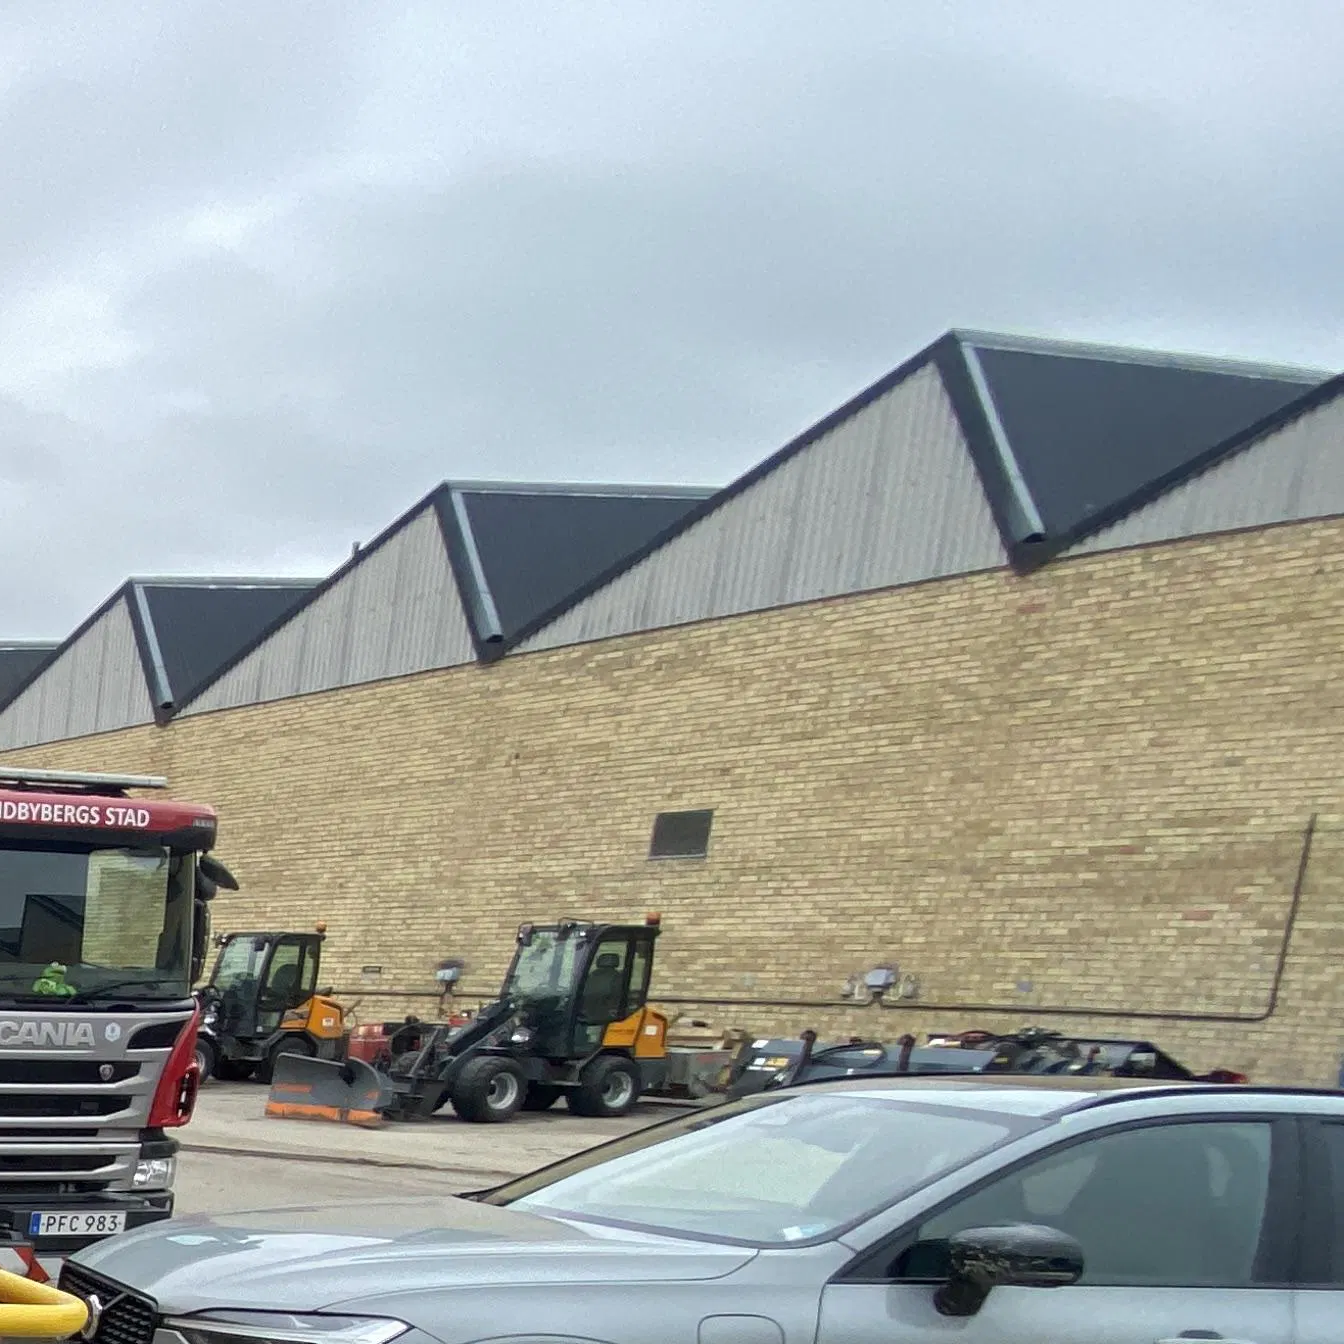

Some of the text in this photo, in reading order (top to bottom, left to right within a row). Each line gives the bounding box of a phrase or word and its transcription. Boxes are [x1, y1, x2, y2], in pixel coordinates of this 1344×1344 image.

[105, 807, 150, 827] STAD
[45, 1215, 118, 1233] PFC 983
